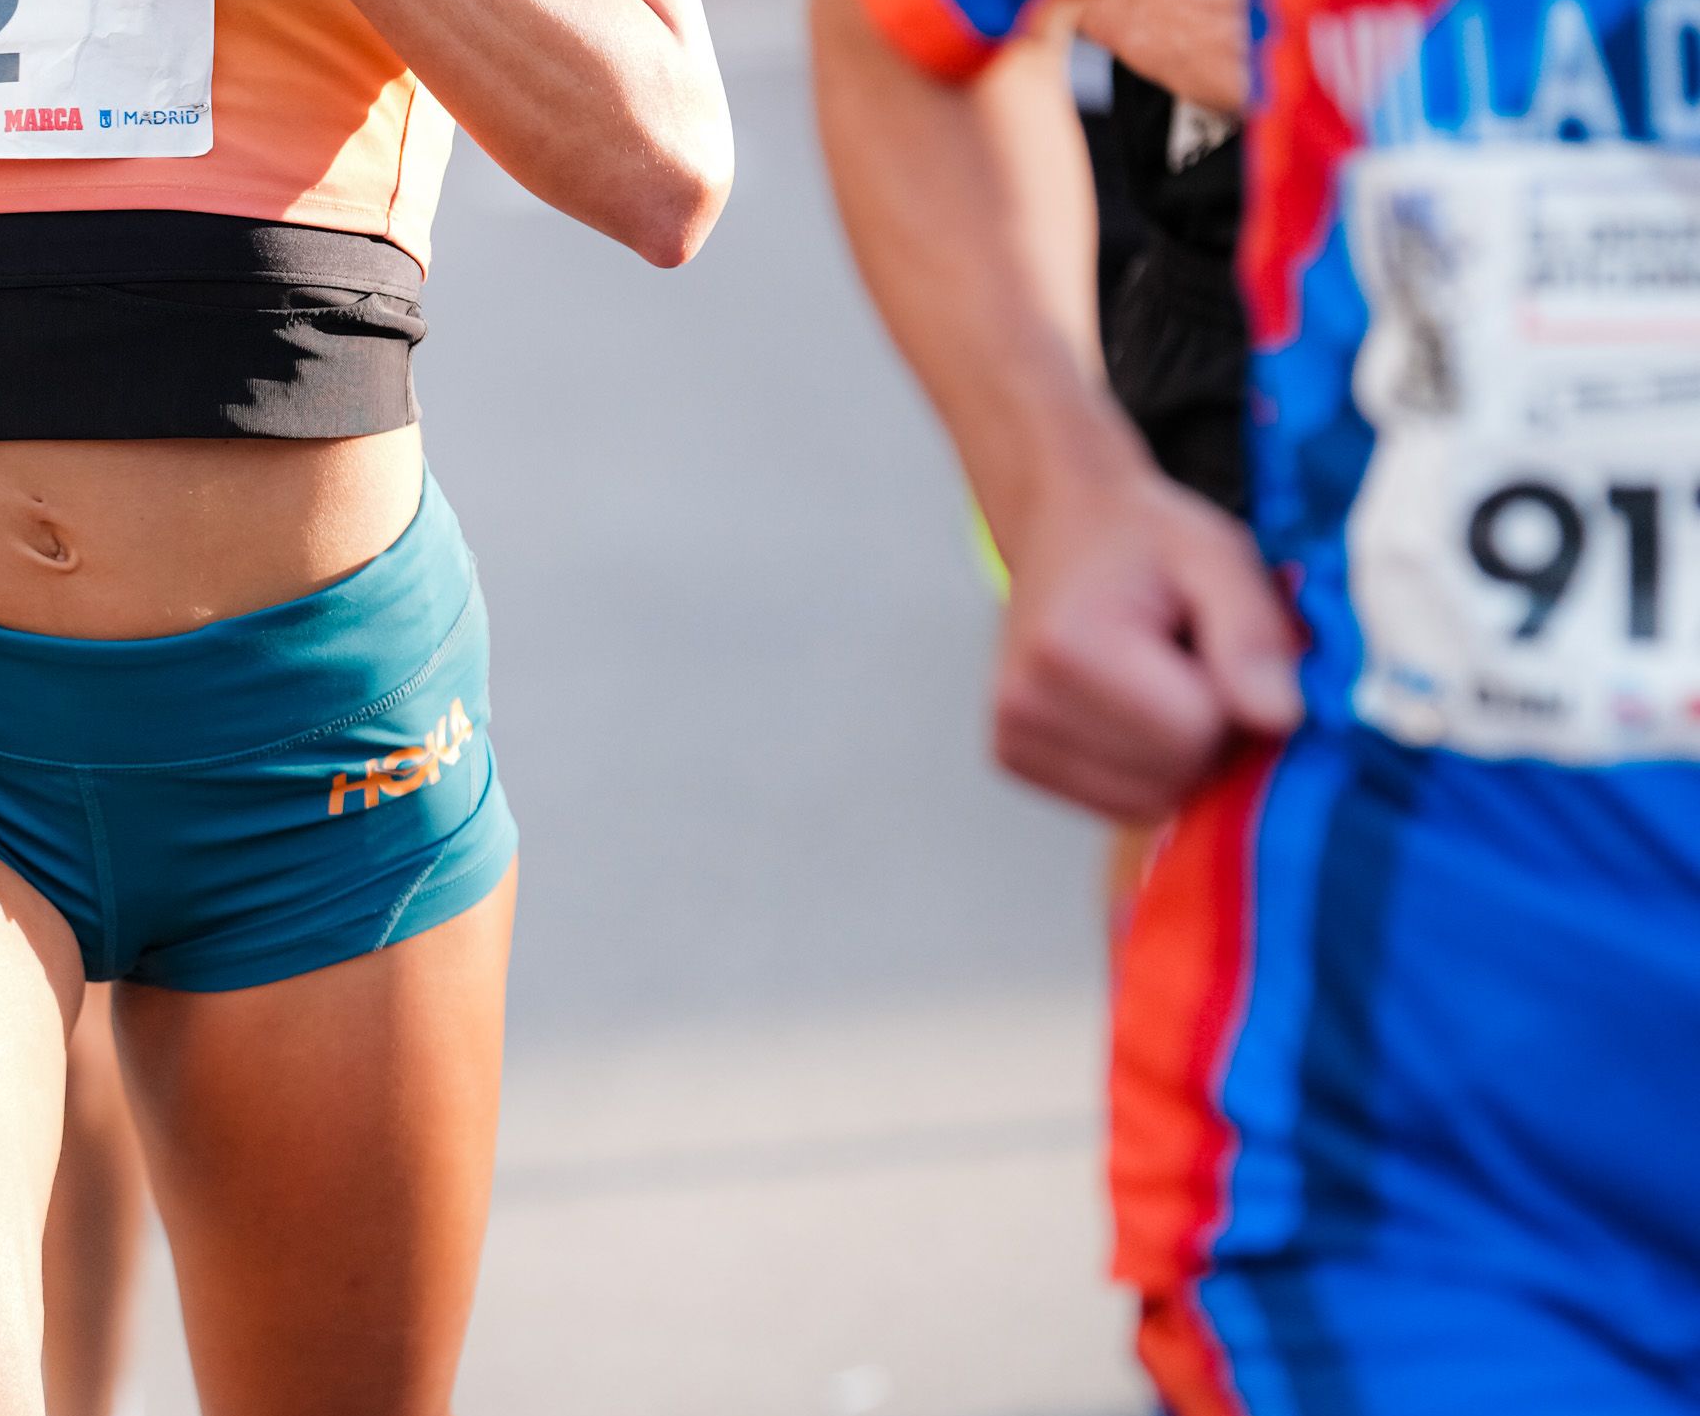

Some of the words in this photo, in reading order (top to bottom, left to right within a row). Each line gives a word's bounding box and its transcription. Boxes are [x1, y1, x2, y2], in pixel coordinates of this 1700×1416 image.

[4, 107, 83, 132] MARCA
[124, 110, 199, 126] MADRID
[1466, 483, 1700, 643] 91
[328, 698, 473, 815] HOKA
